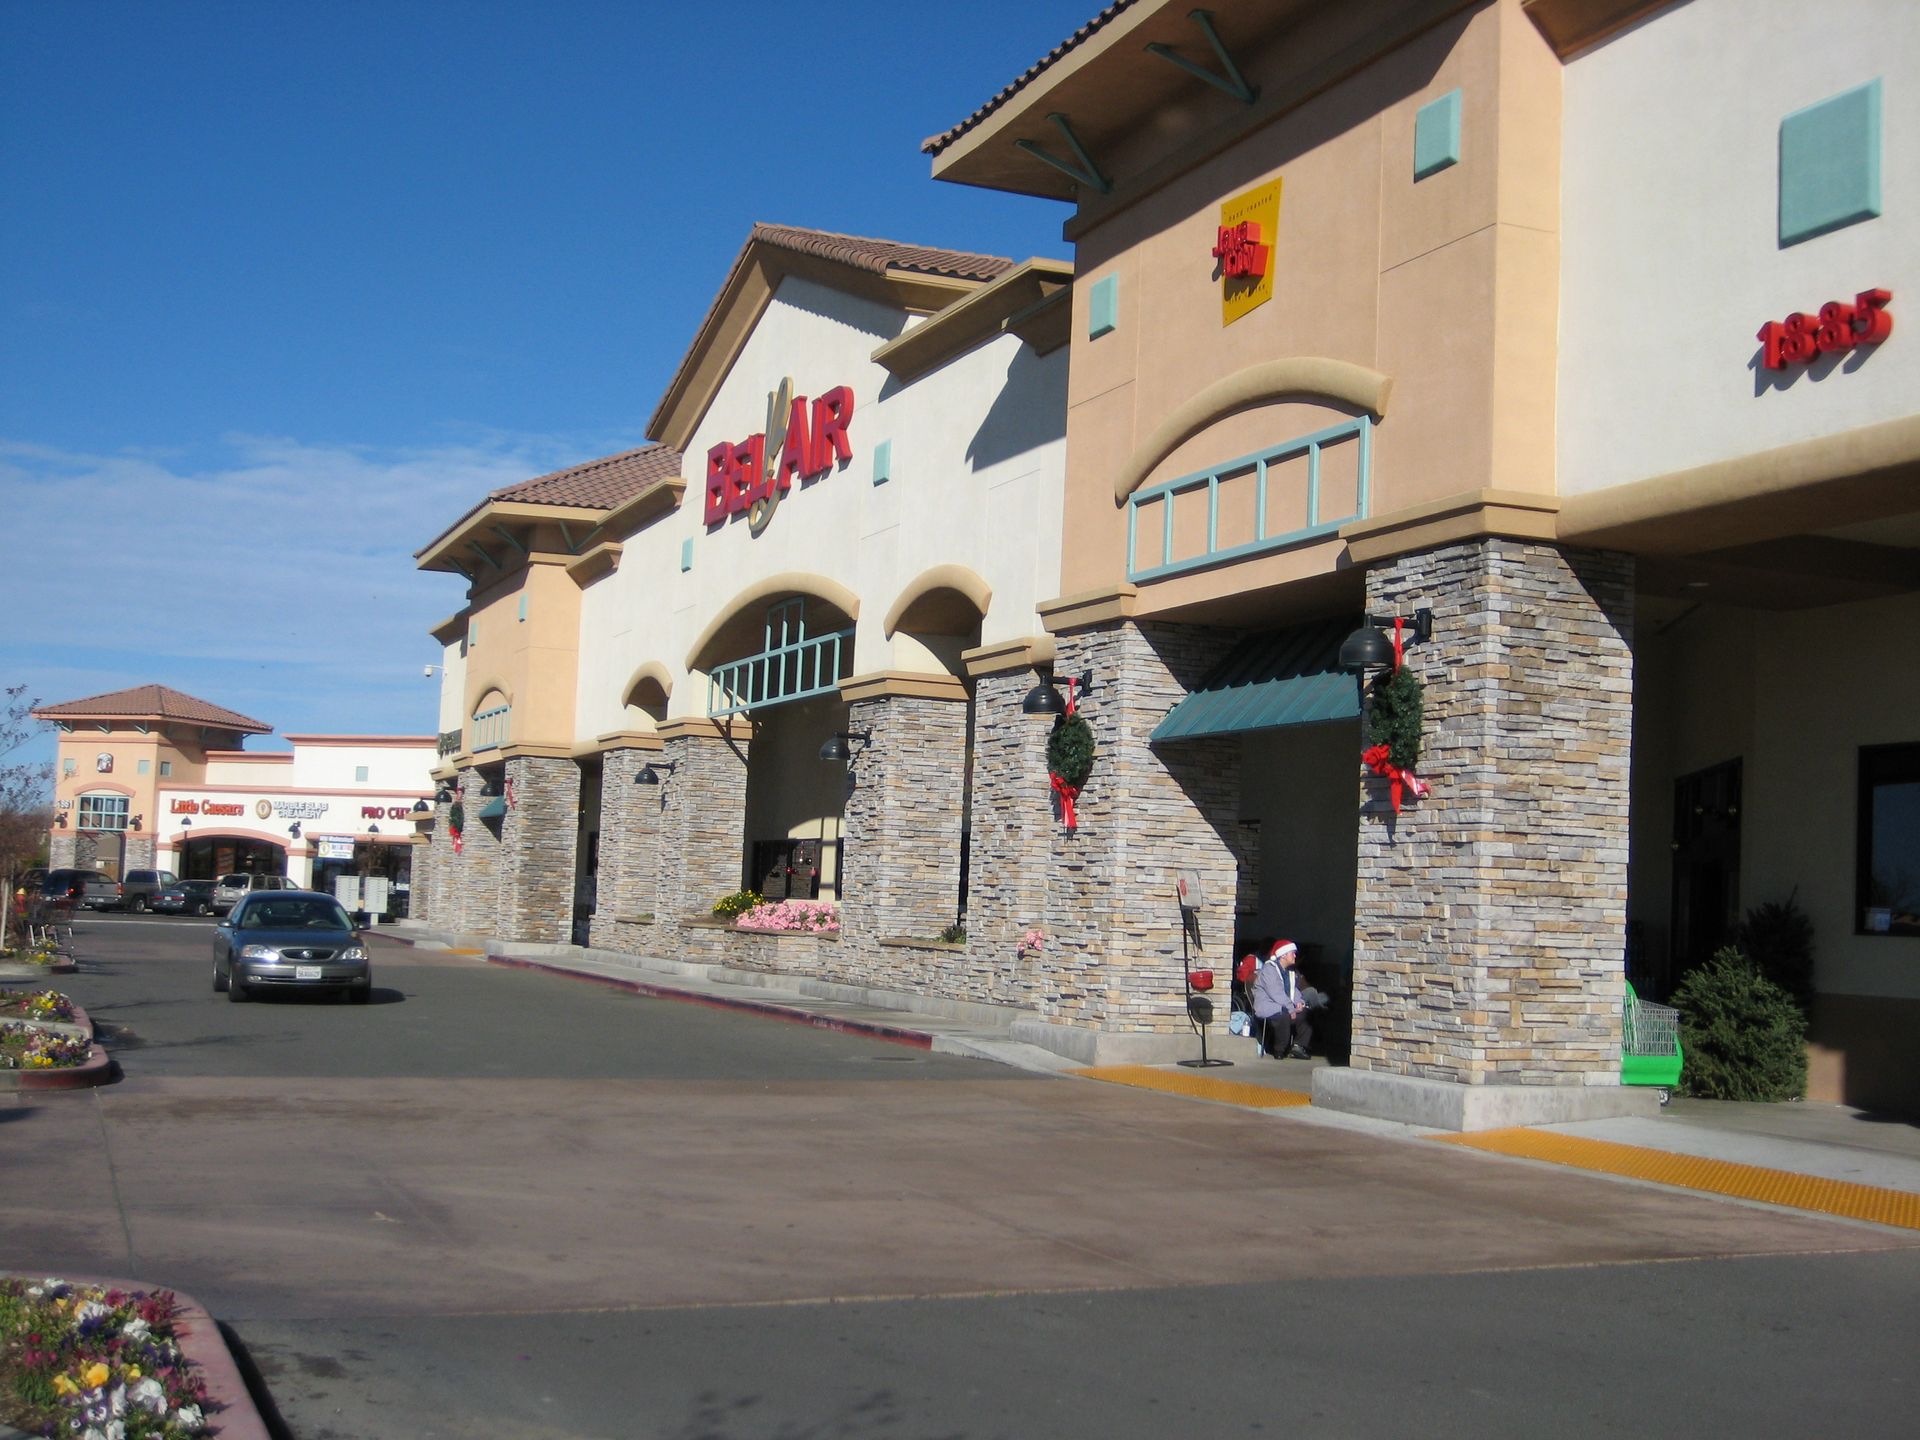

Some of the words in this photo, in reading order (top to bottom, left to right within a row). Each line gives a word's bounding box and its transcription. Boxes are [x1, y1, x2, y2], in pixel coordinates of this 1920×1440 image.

[1756, 288, 1893, 369] 1885
[703, 433, 776, 525] BEL
[776, 385, 855, 491] AIR
[170, 799, 199, 814] Little
[201, 799, 245, 816] Caesars
[273, 801, 306, 811] MARBLE
[306, 802, 329, 812] SLAB
[361, 806, 385, 820] PRO
[278, 810, 323, 819] CREAMERY
